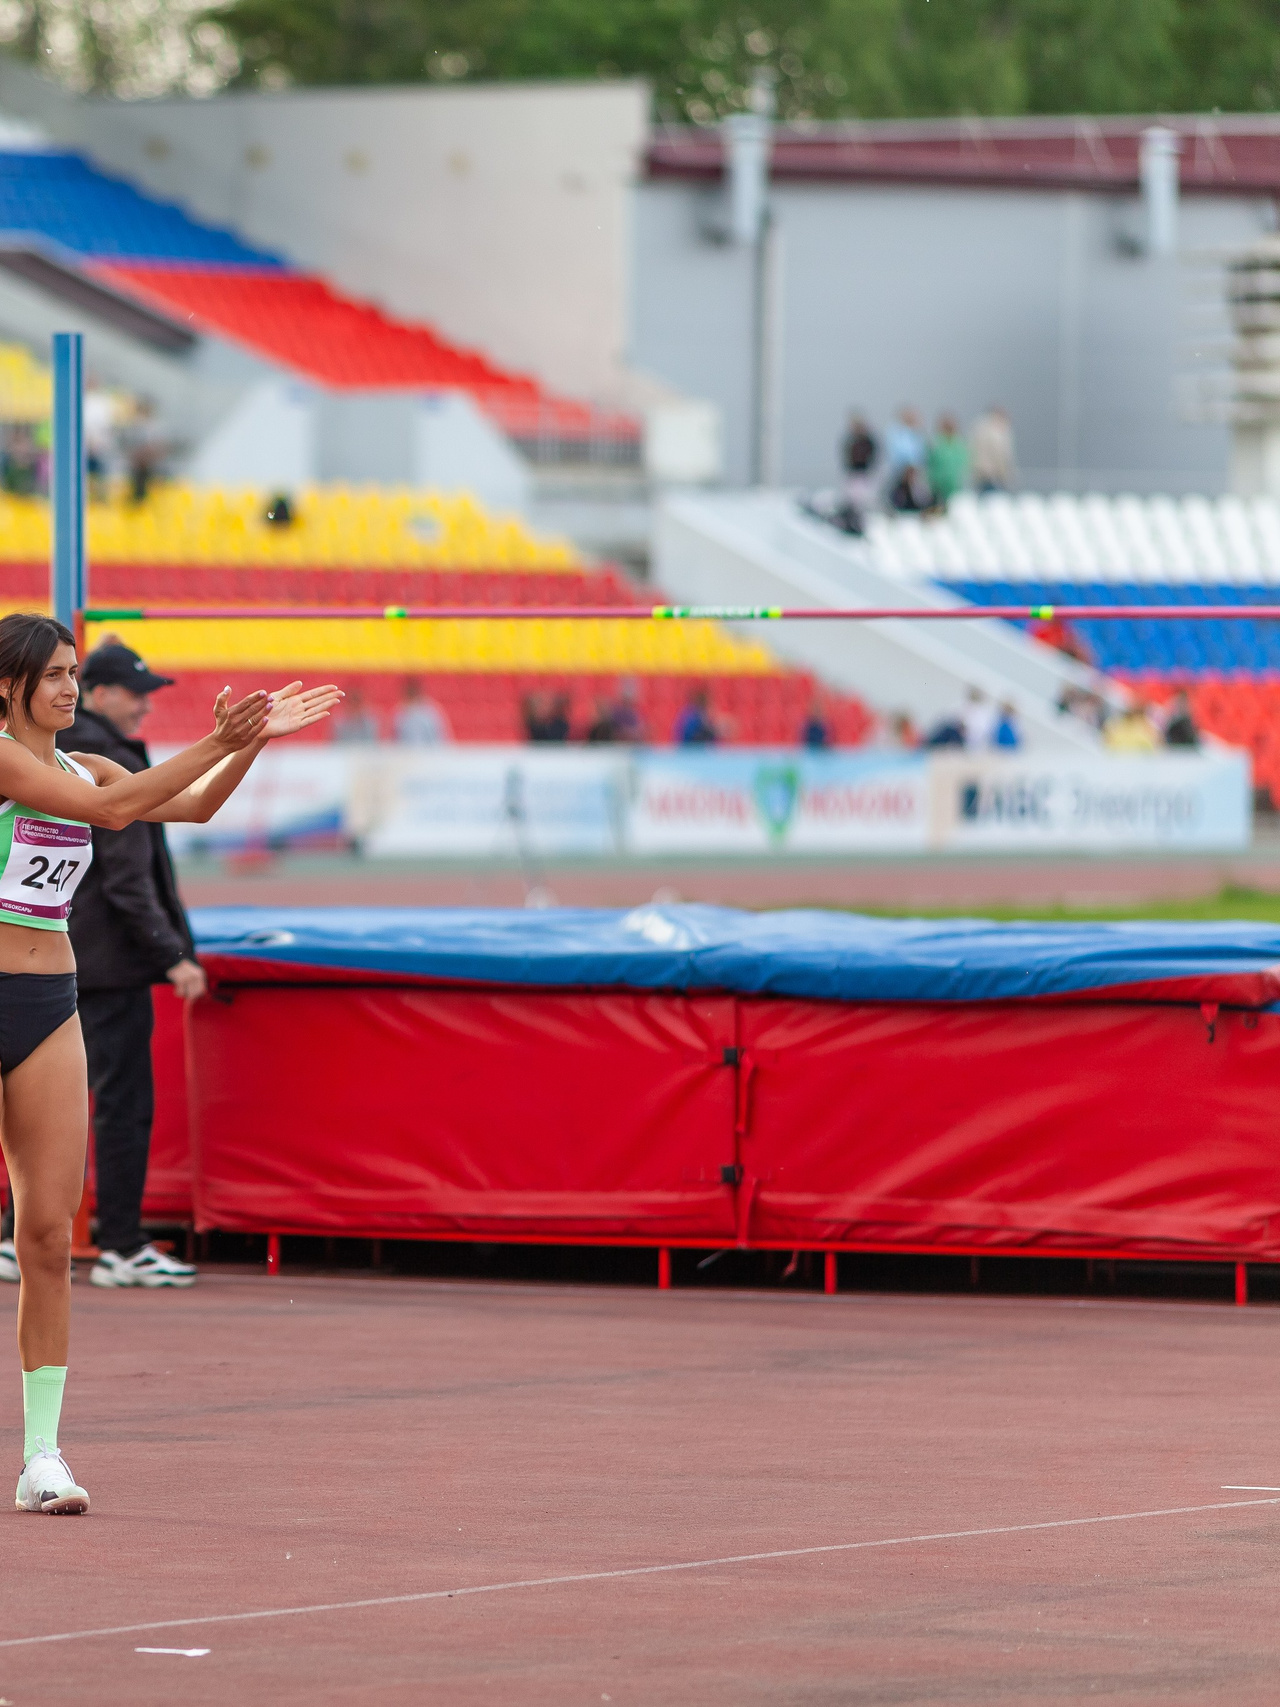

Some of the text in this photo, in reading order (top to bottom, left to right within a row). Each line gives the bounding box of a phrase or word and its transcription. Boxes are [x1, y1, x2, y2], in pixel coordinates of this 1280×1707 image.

[21, 823, 59, 835] ПЕРВЕНСТВО
[20, 830, 56, 840] ПРИВОЛЖСКОГО
[21, 855, 80, 892] 247
[1, 902, 33, 913] ЧЕБОКСАРЫ
